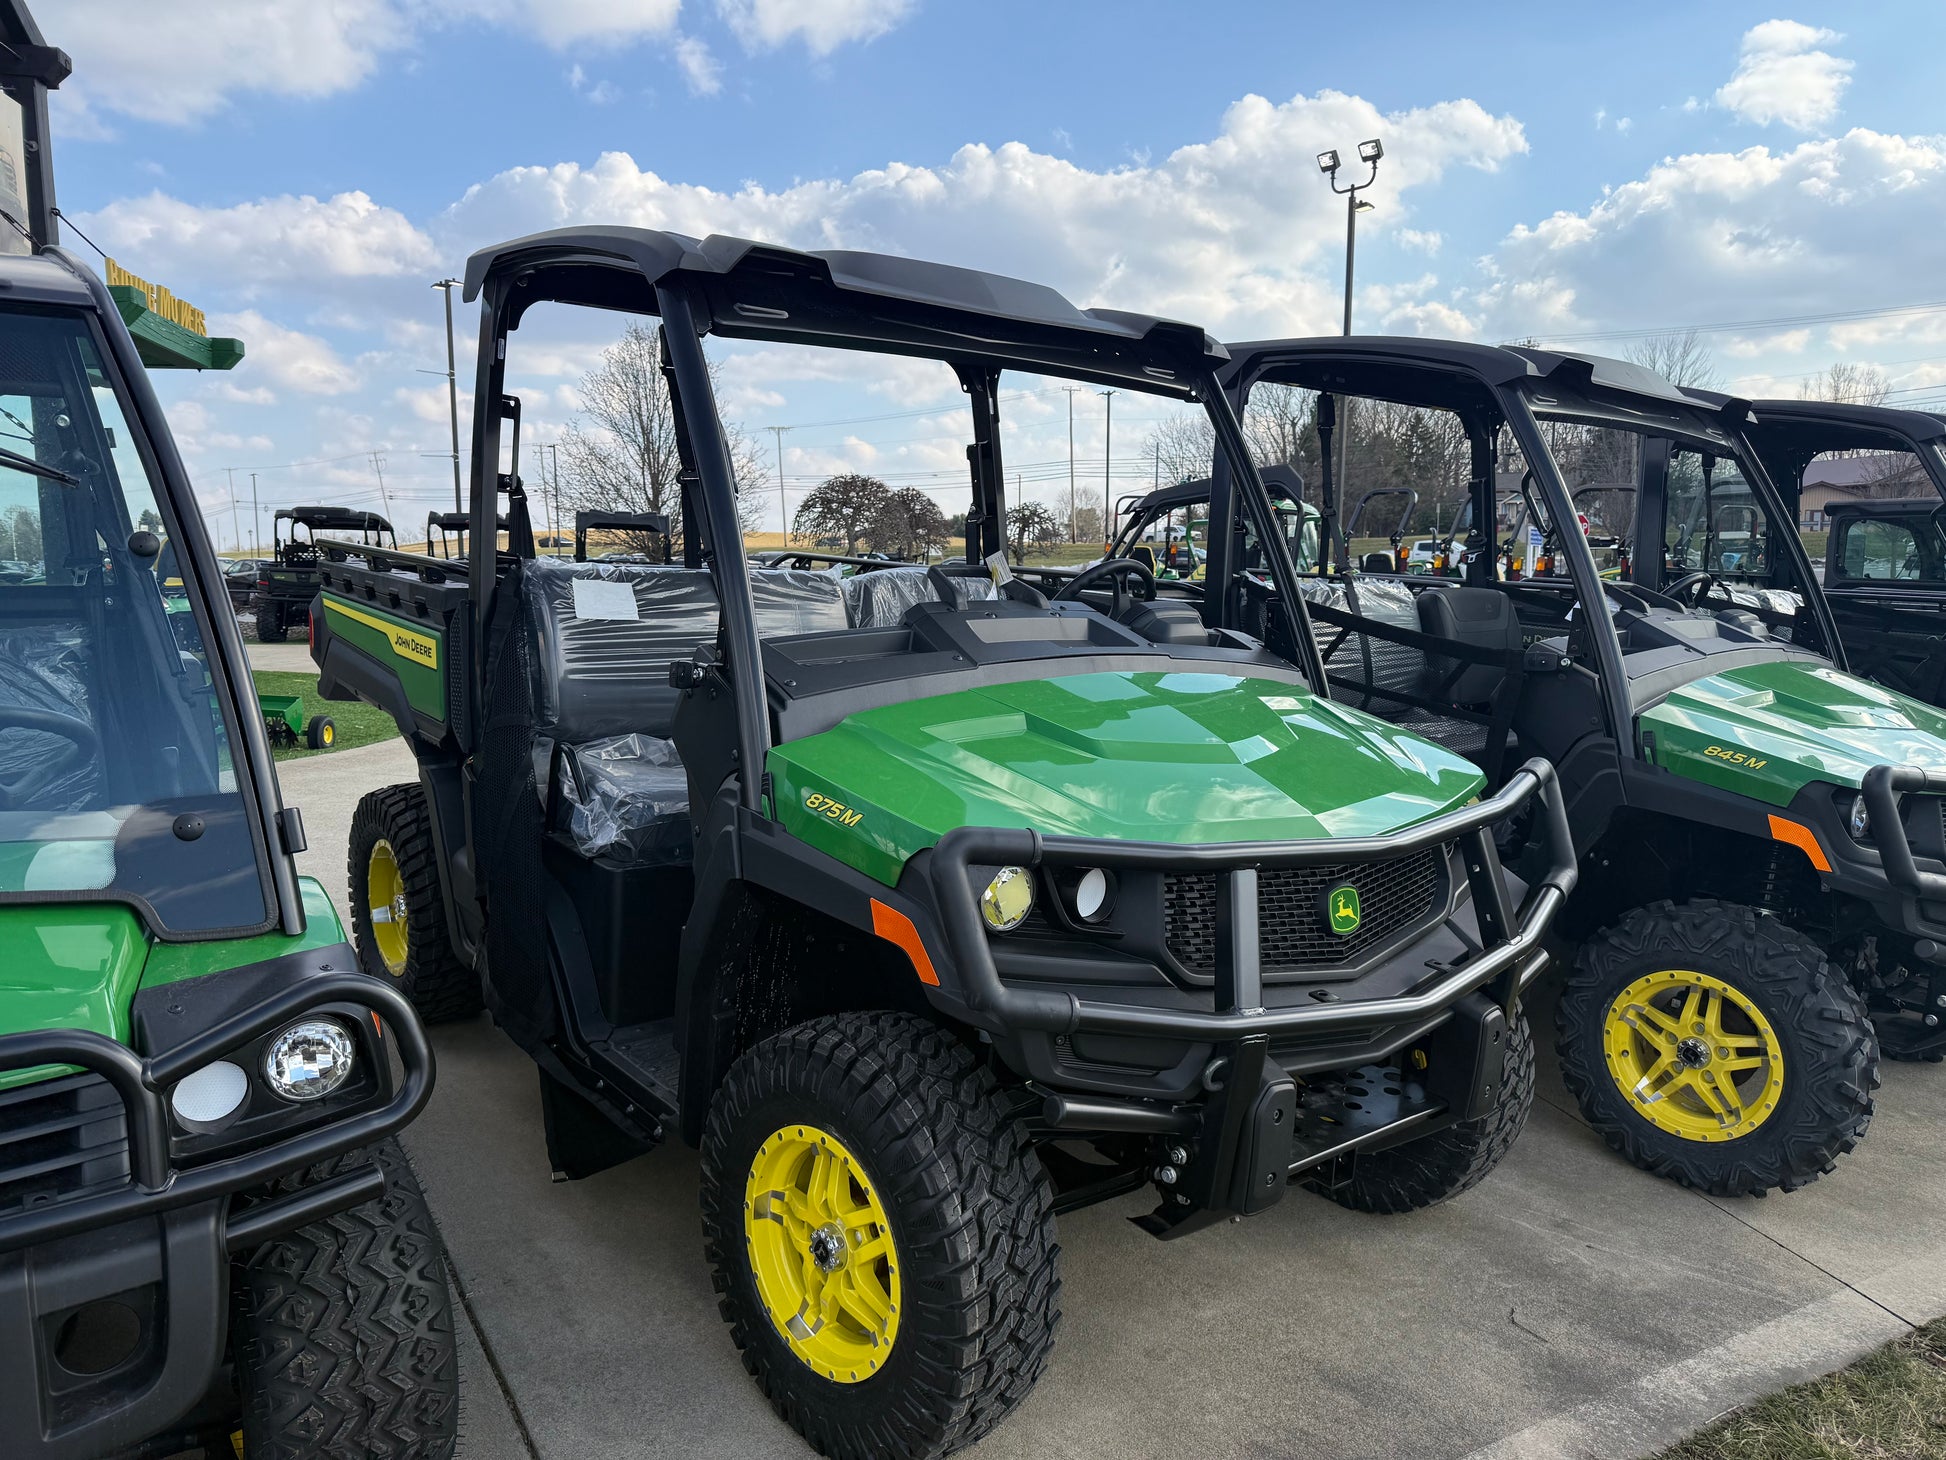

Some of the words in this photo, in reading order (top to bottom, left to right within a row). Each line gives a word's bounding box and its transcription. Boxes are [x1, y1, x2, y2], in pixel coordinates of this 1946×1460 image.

[156, 285, 207, 336] MOWERS
[395, 633, 411, 650] JOHN
[411, 639, 432, 658] DEERE
[1703, 745, 1767, 770] 845M
[805, 793, 864, 827] 875M
